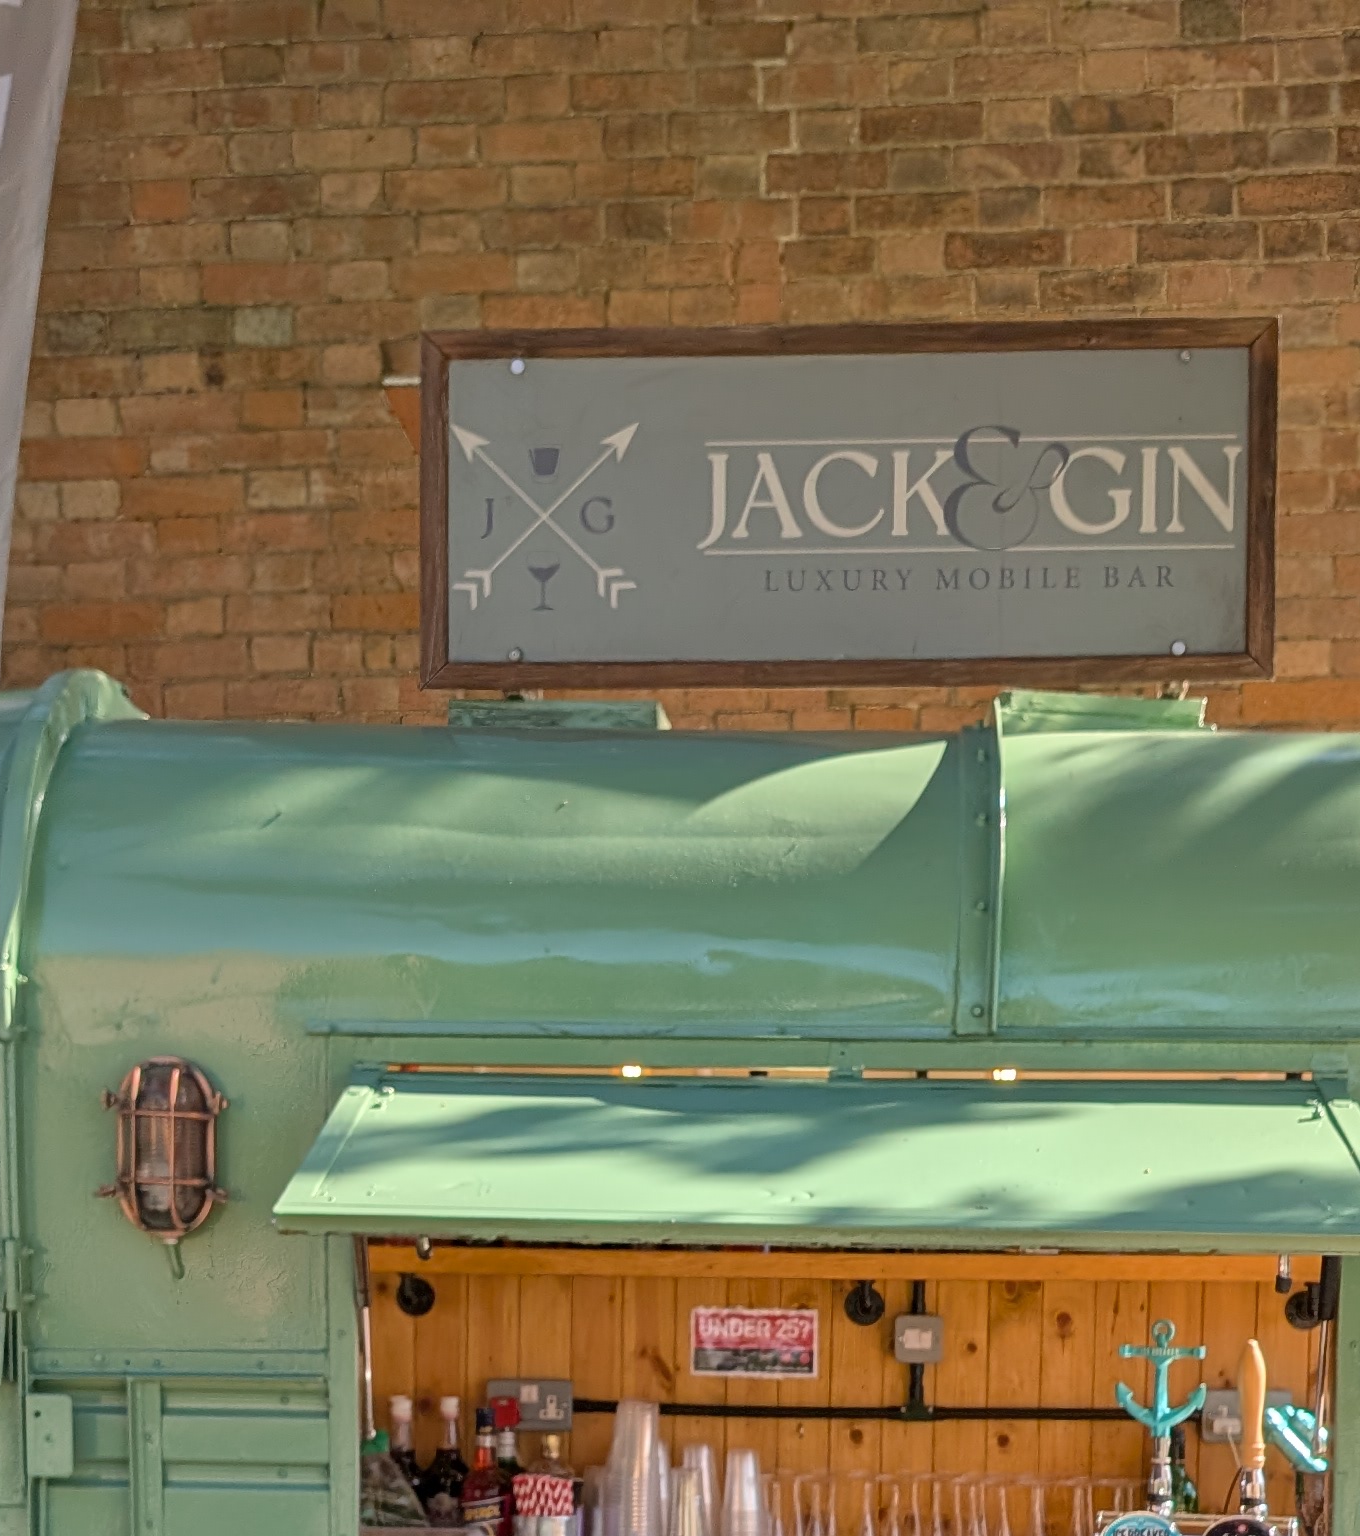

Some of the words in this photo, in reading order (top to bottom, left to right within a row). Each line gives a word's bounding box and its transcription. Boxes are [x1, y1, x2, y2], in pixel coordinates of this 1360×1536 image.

[481, 497, 495, 540] J
[579, 497, 616, 536] G
[764, 567, 912, 593] LUXURY
[936, 565, 1082, 591] MOBILE
[1104, 563, 1176, 589] BAR
[698, 1317, 772, 1339] UNDER
[774, 1317, 810, 1339] 25?
